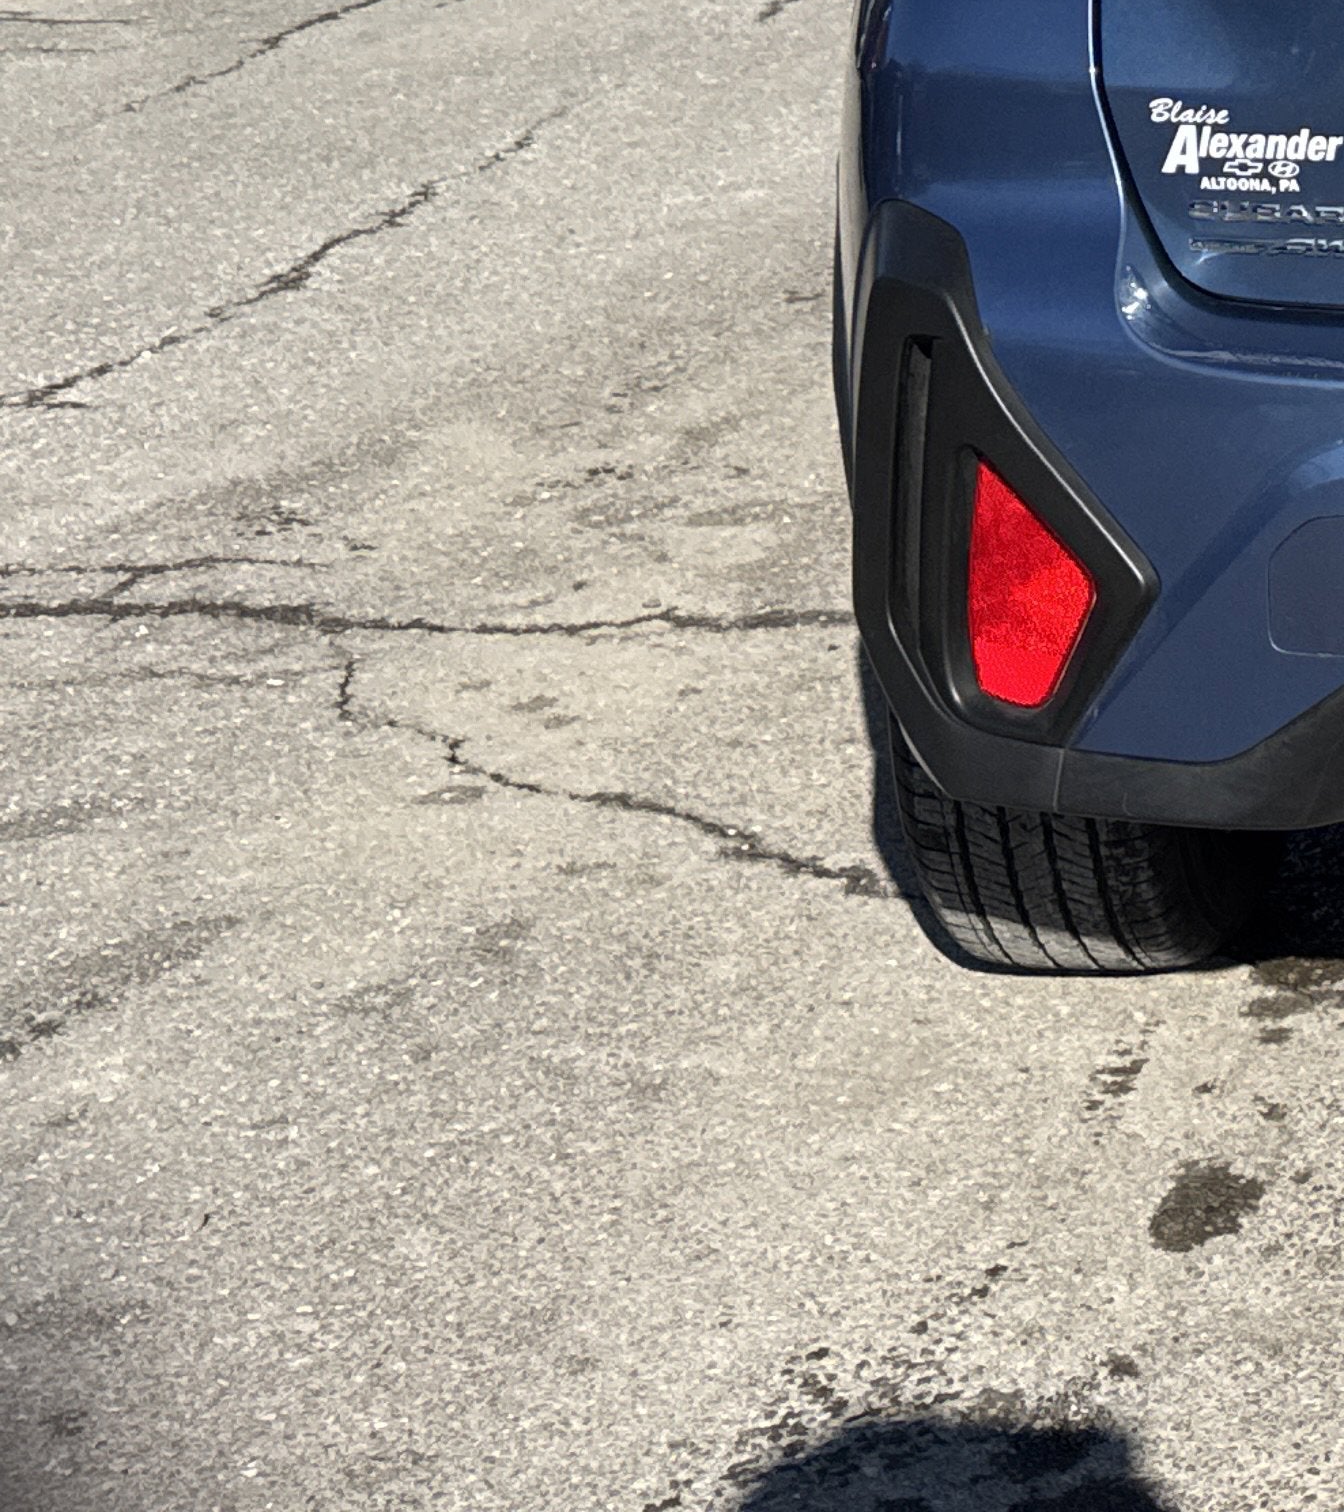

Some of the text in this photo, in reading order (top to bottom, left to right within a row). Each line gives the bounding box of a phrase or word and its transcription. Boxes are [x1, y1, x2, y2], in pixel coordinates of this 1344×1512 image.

[1149, 98, 1230, 124] Blaise
[1161, 124, 1344, 174] Alexander
[1200, 177, 1300, 194] ALTOONA, PA
